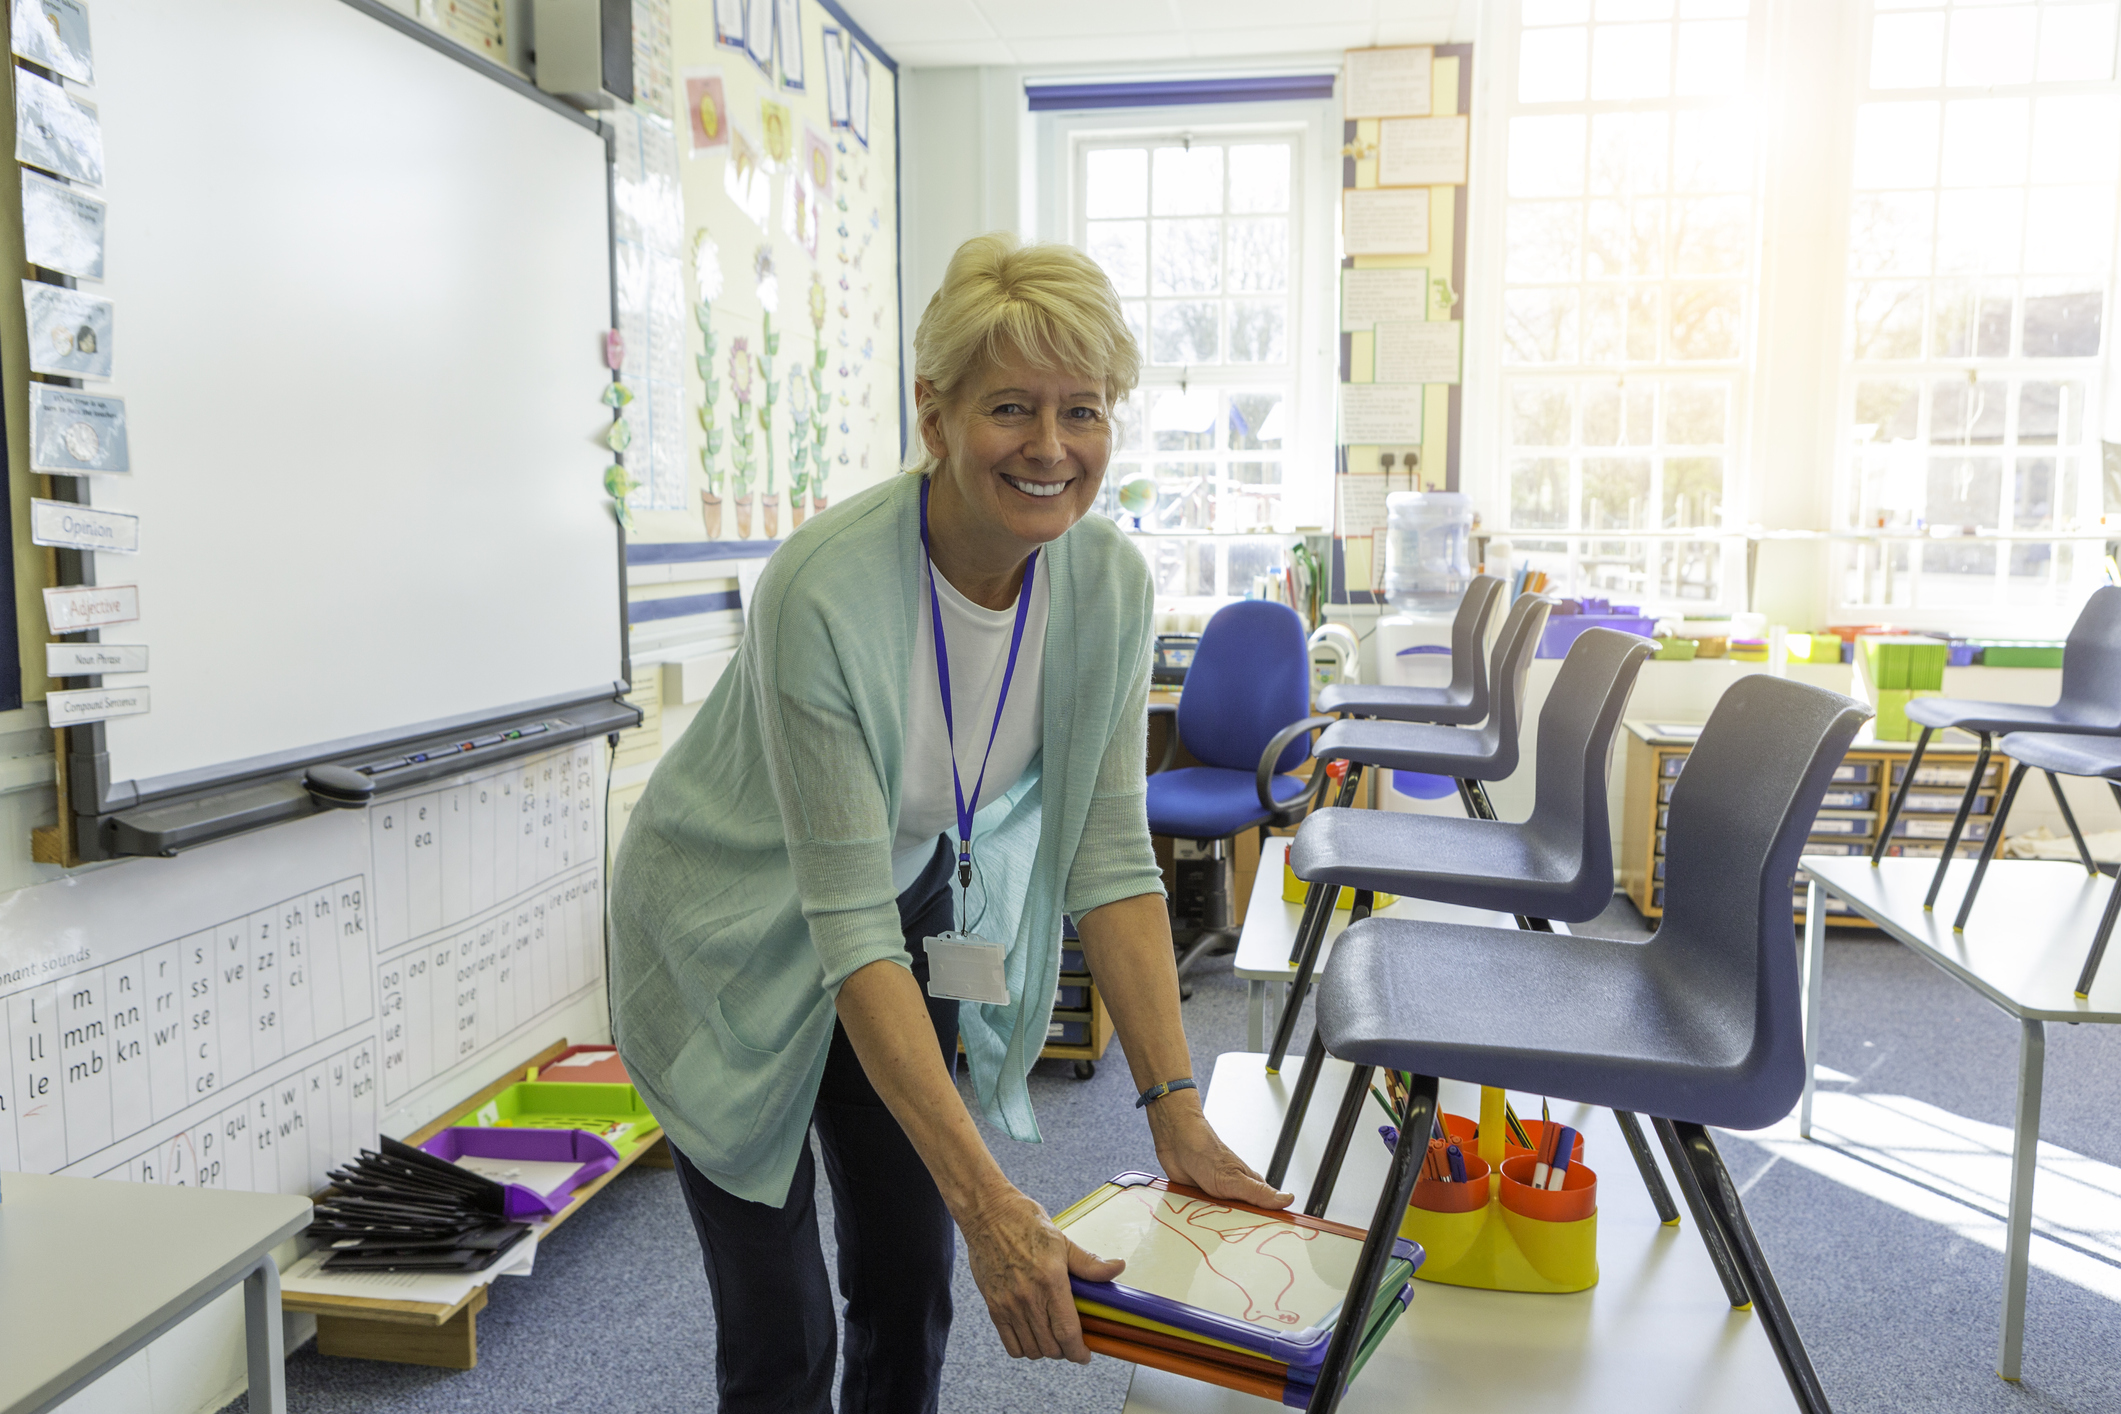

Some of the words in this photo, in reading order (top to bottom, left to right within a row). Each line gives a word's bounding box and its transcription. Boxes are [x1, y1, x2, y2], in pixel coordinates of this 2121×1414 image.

[62, 515, 114, 540] Opinion
[70, 599, 122, 622] Adjective
[75, 654, 95, 665] Noun
[96, 652, 122, 665] Phrase
[64, 697, 103, 715] Compound
[104, 696, 137, 709] Sentence
[480, 791, 488, 804] o
[504, 783, 511, 796] u
[453, 794, 459, 812] i
[383, 815, 393, 830] a
[418, 806, 427, 821] e
[414, 831, 432, 848] ea
[564, 885, 580, 902] ear
[581, 877, 598, 894] ure
[314, 895, 331, 918] th
[342, 890, 362, 912] ng
[285, 905, 303, 930] sh
[344, 913, 364, 936] nk
[261, 923, 270, 939] z
[479, 927, 495, 947] air
[228, 934, 239, 951] v
[290, 935, 301, 957] ti
[460, 939, 473, 956] or
[500, 943, 512, 960] ur
[0, 962, 37, 986] nant
[42, 946, 92, 972] sounds
[194, 948, 203, 964] s
[258, 951, 275, 971] zz
[435, 949, 451, 967] ar
[477, 952, 496, 972] are
[159, 960, 168, 978] r
[224, 964, 244, 983] ve
[290, 964, 303, 987] ci
[408, 959, 427, 978] oo
[457, 961, 477, 983] oor
[119, 975, 131, 993] n
[191, 977, 209, 998] ss
[382, 971, 400, 989] oo
[73, 989, 92, 1010] m
[263, 983, 271, 999] s
[458, 987, 476, 1007] ore
[31, 998, 38, 1024] l
[157, 991, 173, 1012] rr
[115, 1006, 140, 1030] nn
[192, 1009, 210, 1030] se
[259, 1011, 276, 1031] se
[459, 1012, 476, 1031] aw
[64, 1020, 104, 1049] mm
[154, 1022, 179, 1046] wr
[385, 1023, 402, 1042] ue
[29, 1033, 44, 1061] ll
[117, 1039, 141, 1064] kn
[199, 1042, 208, 1059] c
[460, 1037, 475, 1055] au
[69, 1050, 103, 1083] mb
[353, 1046, 370, 1070] ch
[385, 1049, 404, 1070] ew
[196, 1072, 215, 1093] ce
[311, 1076, 320, 1092] x
[334, 1064, 343, 1086] y
[29, 1073, 49, 1099] le
[353, 1072, 373, 1099] tch
[282, 1087, 296, 1106] w
[259, 1100, 266, 1118] t
[226, 1114, 247, 1140] qu
[279, 1109, 304, 1138] wh
[203, 1132, 214, 1157] p
[258, 1127, 272, 1150] tt
[174, 1143, 181, 1174] j
[143, 1160, 154, 1184] h
[200, 1160, 220, 1188] pp
